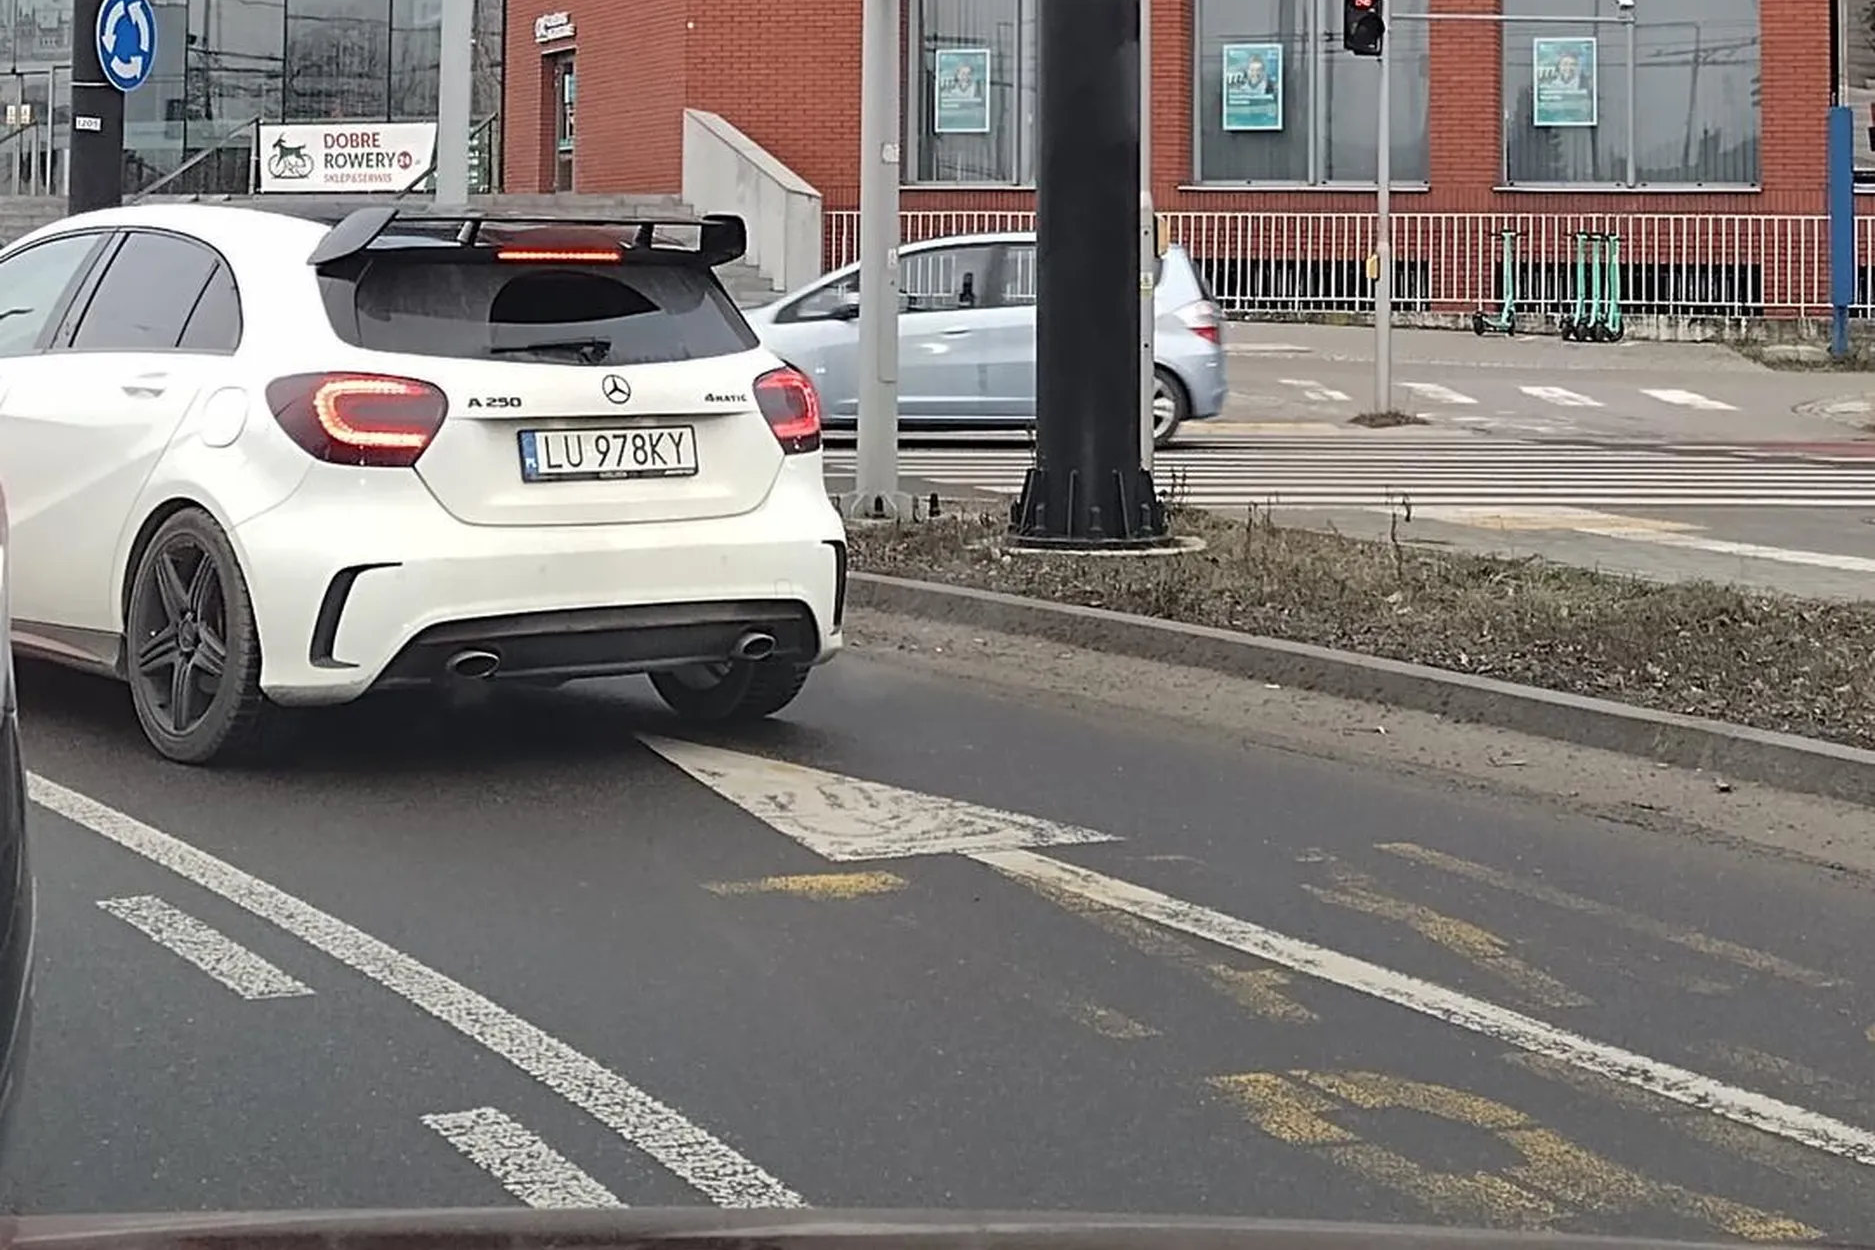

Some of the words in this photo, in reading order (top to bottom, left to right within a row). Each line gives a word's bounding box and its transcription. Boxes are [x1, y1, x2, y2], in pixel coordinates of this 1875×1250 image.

[324, 132, 381, 149] DOBRE
[324, 152, 396, 169] ROWERY
[468, 398, 482, 408] A
[545, 434, 583, 468] LU
[595, 432, 683, 468] 978KY
